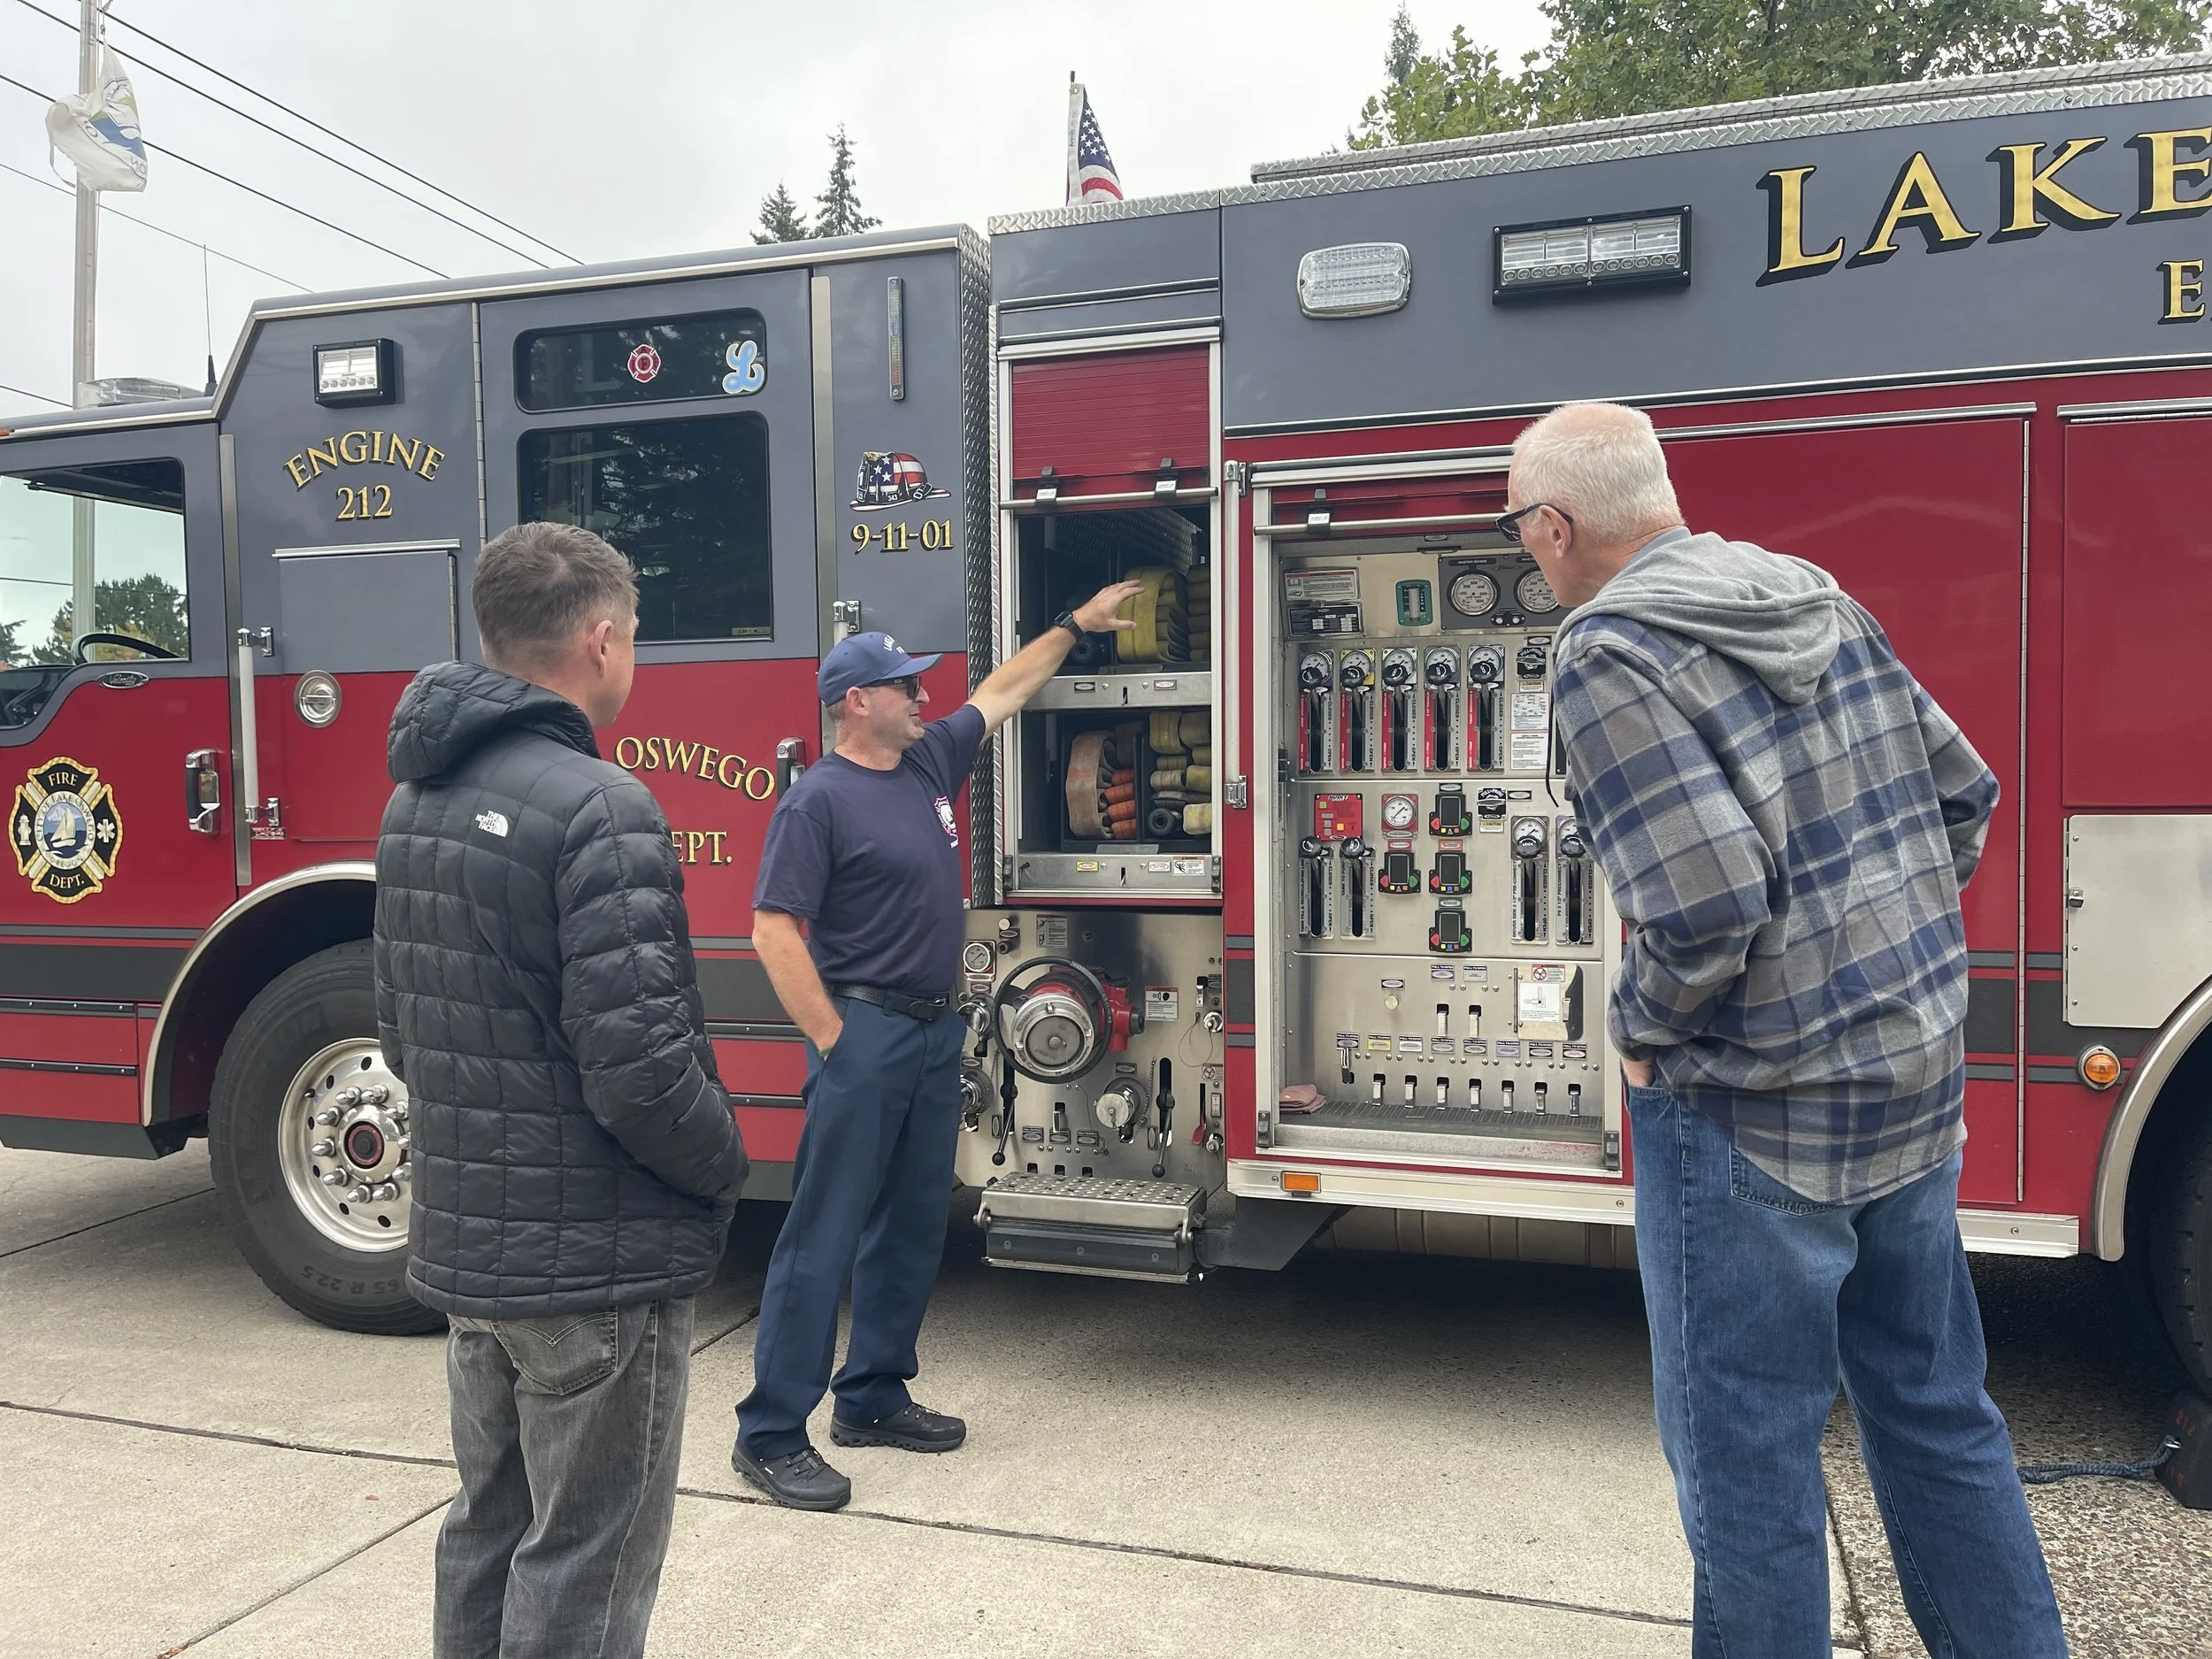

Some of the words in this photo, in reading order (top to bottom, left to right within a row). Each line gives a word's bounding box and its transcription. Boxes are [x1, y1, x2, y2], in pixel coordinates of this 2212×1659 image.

[1755, 126, 2212, 287] LAKE
[2156, 258, 2205, 325] E
[283, 431, 446, 488] ENGINE
[336, 484, 393, 520] 212
[851, 519, 954, 555] 9-11-01
[48, 772, 79, 787] FIRE
[614, 736, 776, 801] OSWEGO
[74, 797, 95, 841] OSWEGO
[50, 855, 85, 868] OREGON
[670, 830, 733, 865] EPT.
[50, 873, 85, 889] DEPT.
